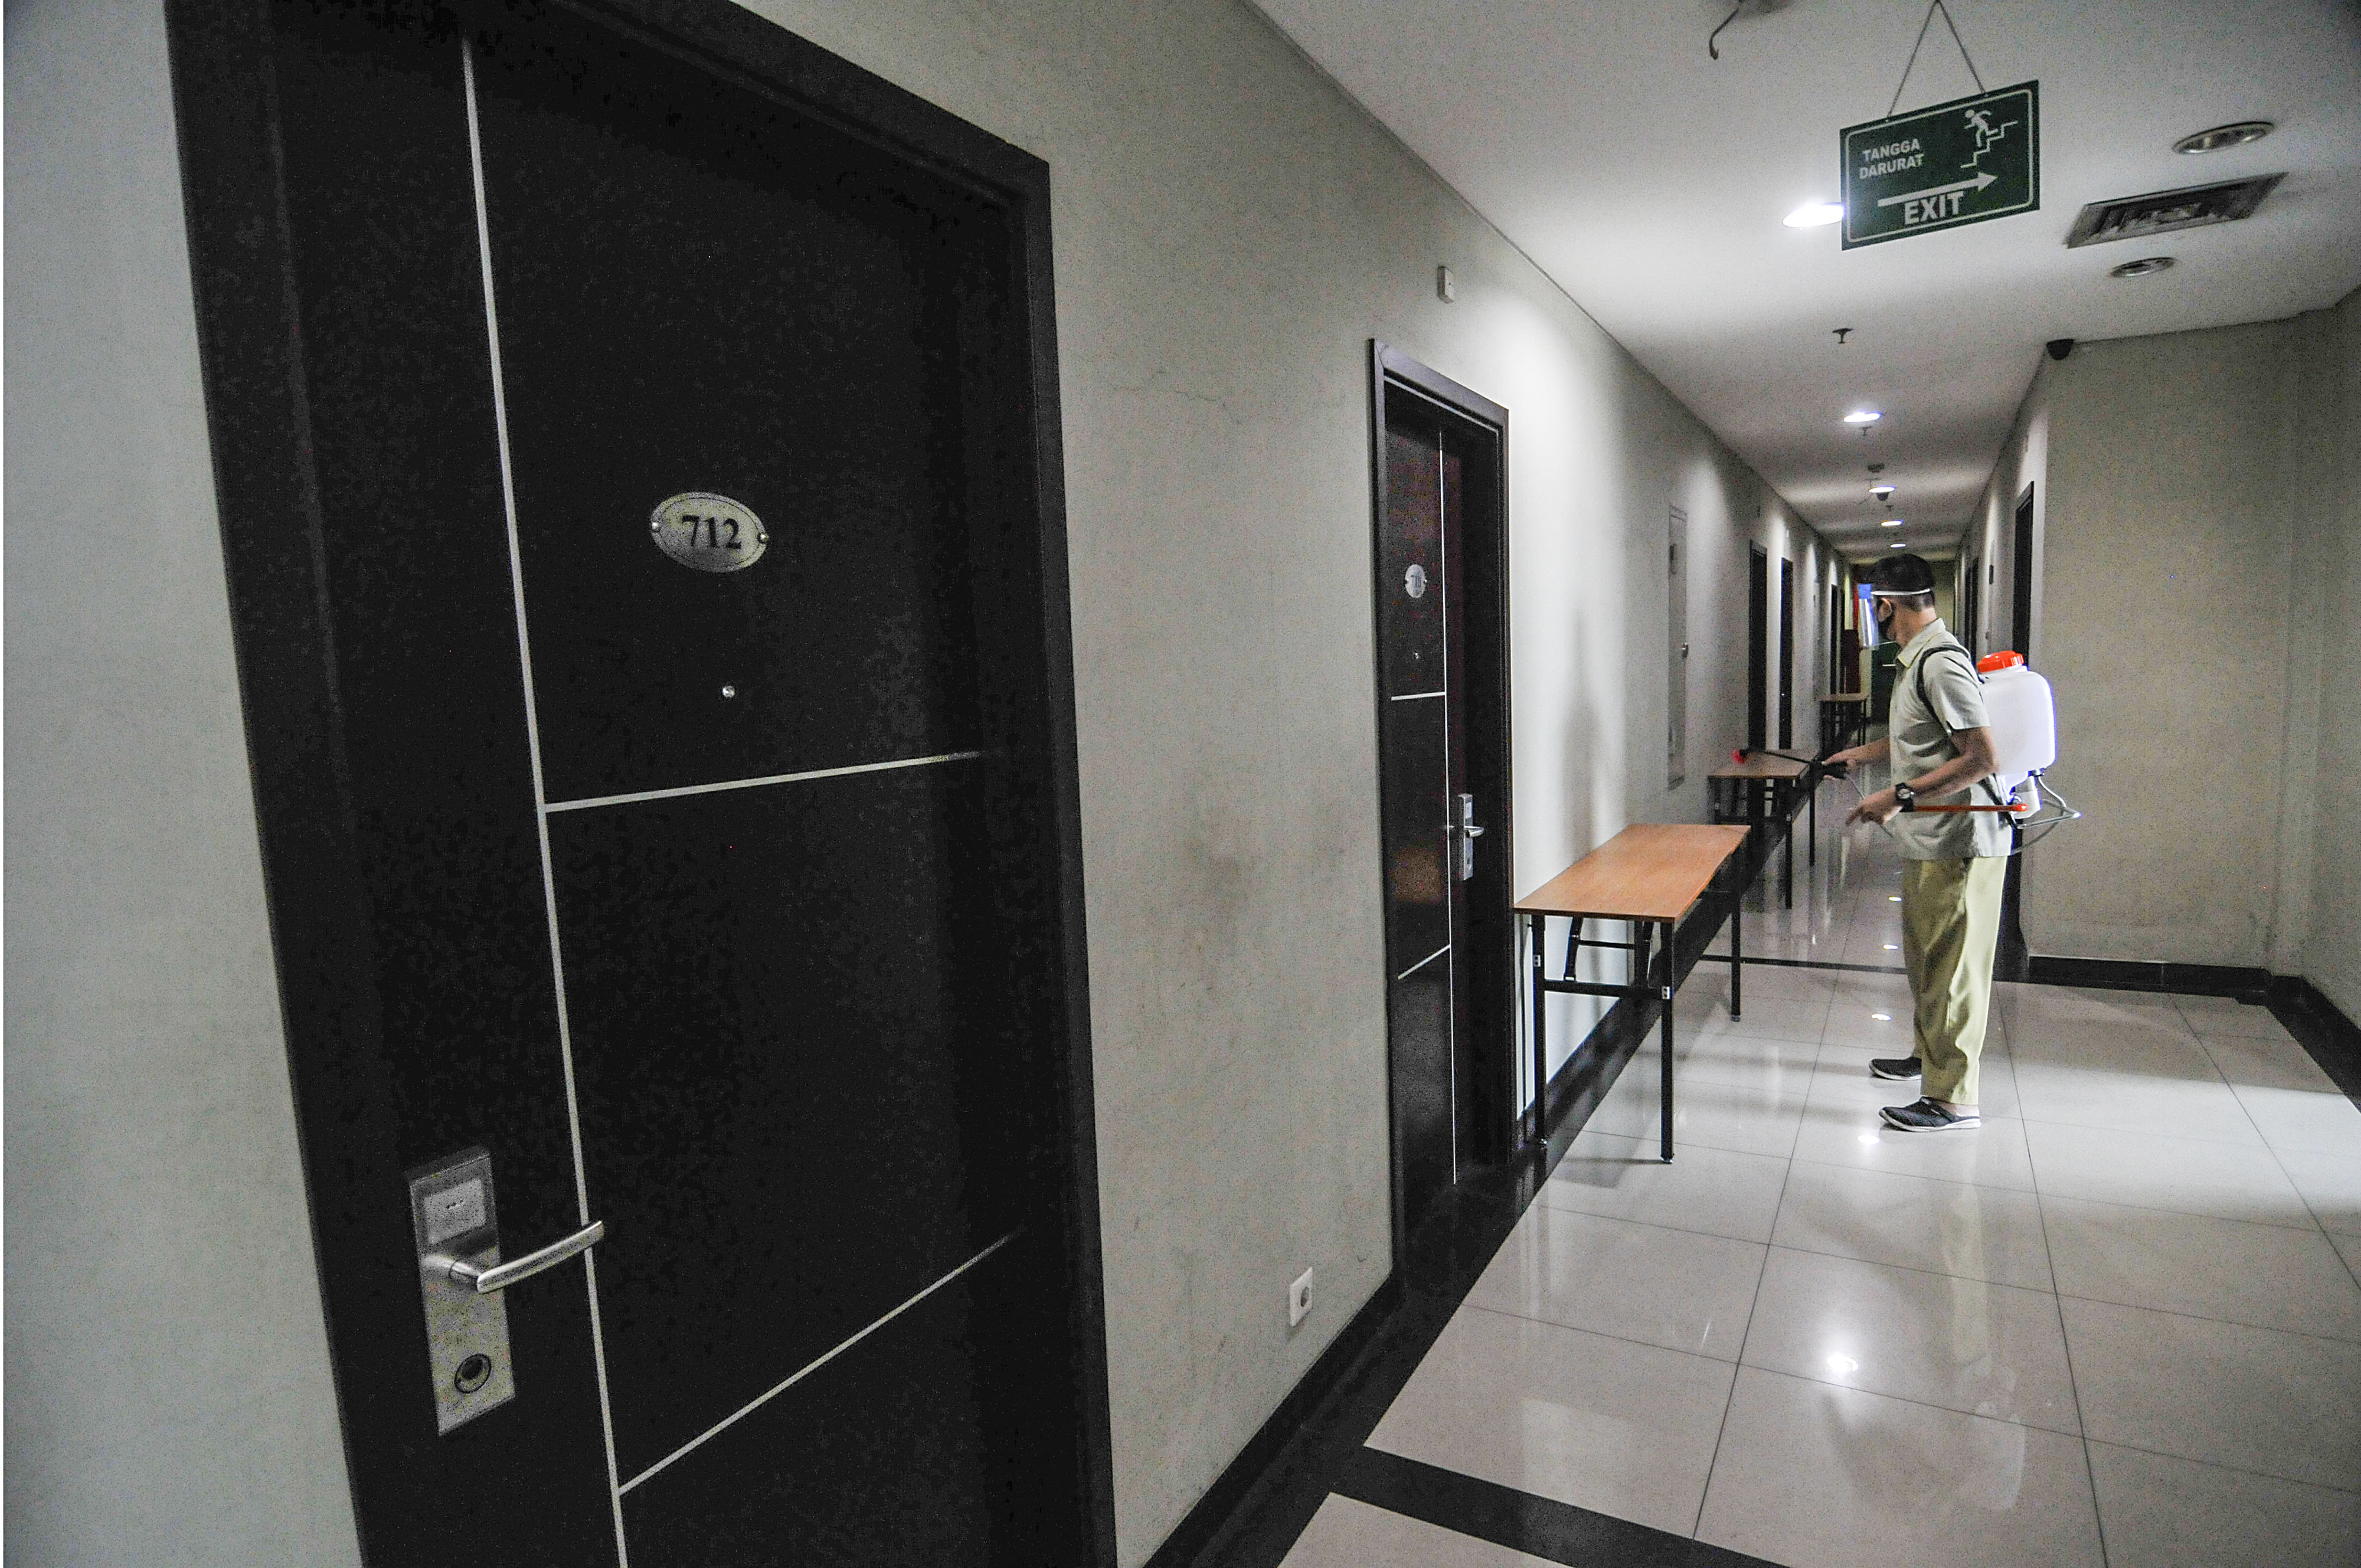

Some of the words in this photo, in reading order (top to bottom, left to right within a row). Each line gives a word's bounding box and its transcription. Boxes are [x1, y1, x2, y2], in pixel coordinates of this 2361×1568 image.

[1863, 138, 1921, 162] TANGGA
[1859, 153, 1925, 179] DARURAT
[1904, 191, 1964, 224] EXIT
[682, 515, 742, 549] 712
